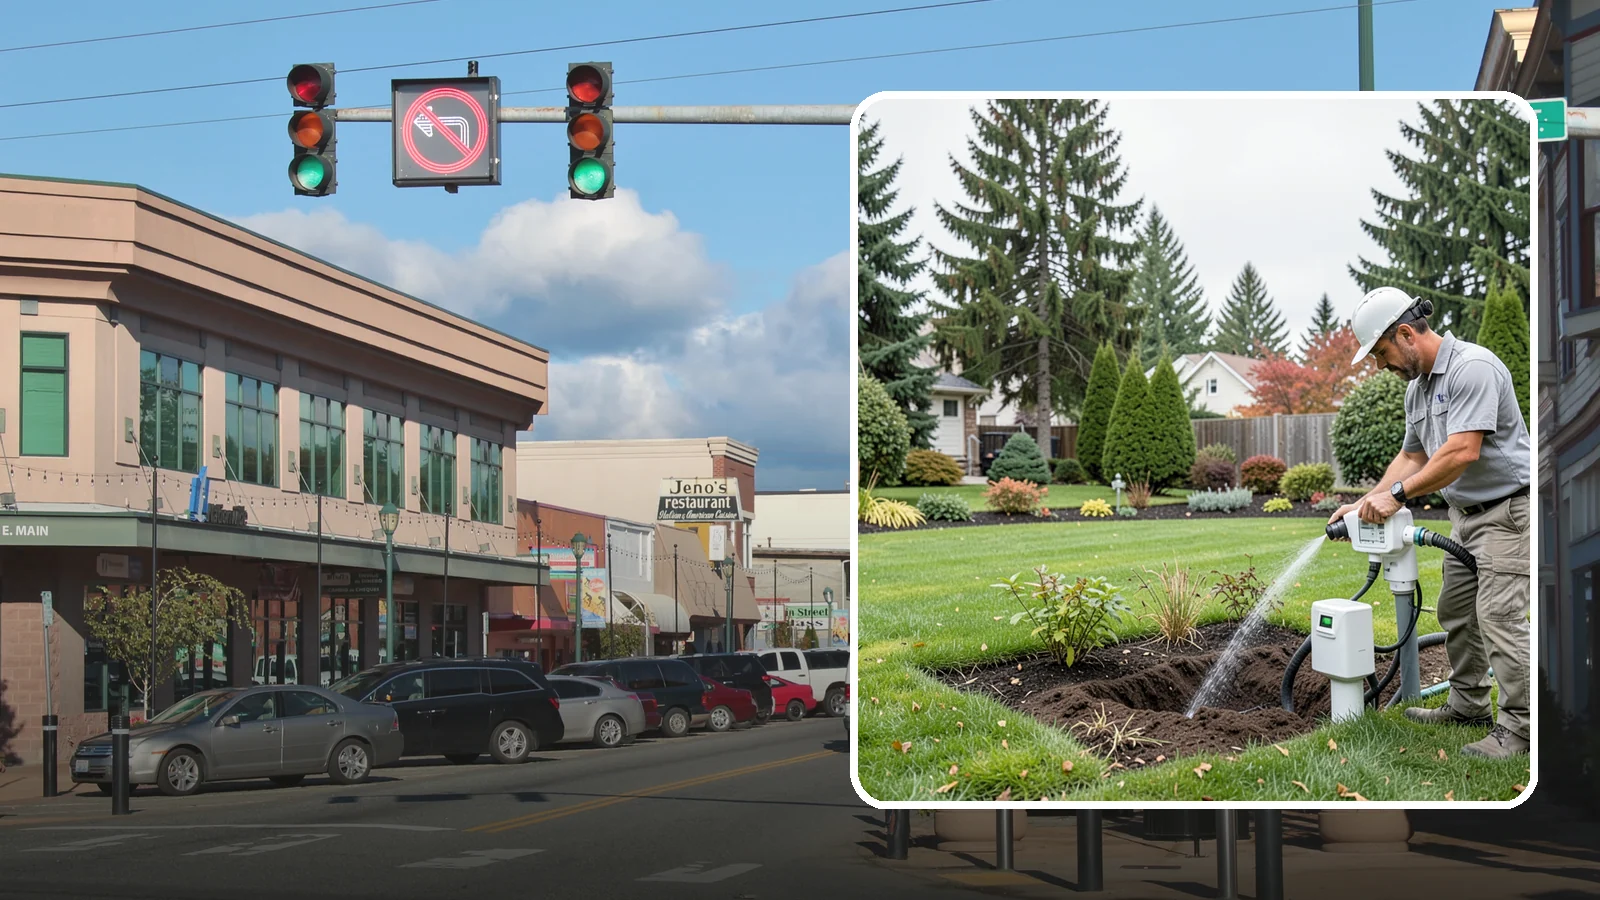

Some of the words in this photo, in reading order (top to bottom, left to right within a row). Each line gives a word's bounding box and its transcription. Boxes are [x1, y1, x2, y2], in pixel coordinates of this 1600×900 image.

[670, 480, 727, 494] Jeno's
[665, 496, 731, 509] restaurant
[658, 510, 681, 519] Italian
[686, 510, 714, 519] American
[715, 509, 737, 519] Cuisine
[2, 525, 13, 536] E.
[16, 525, 49, 536] MAIN
[797, 607, 828, 617] Street
[790, 619, 823, 627] lass
